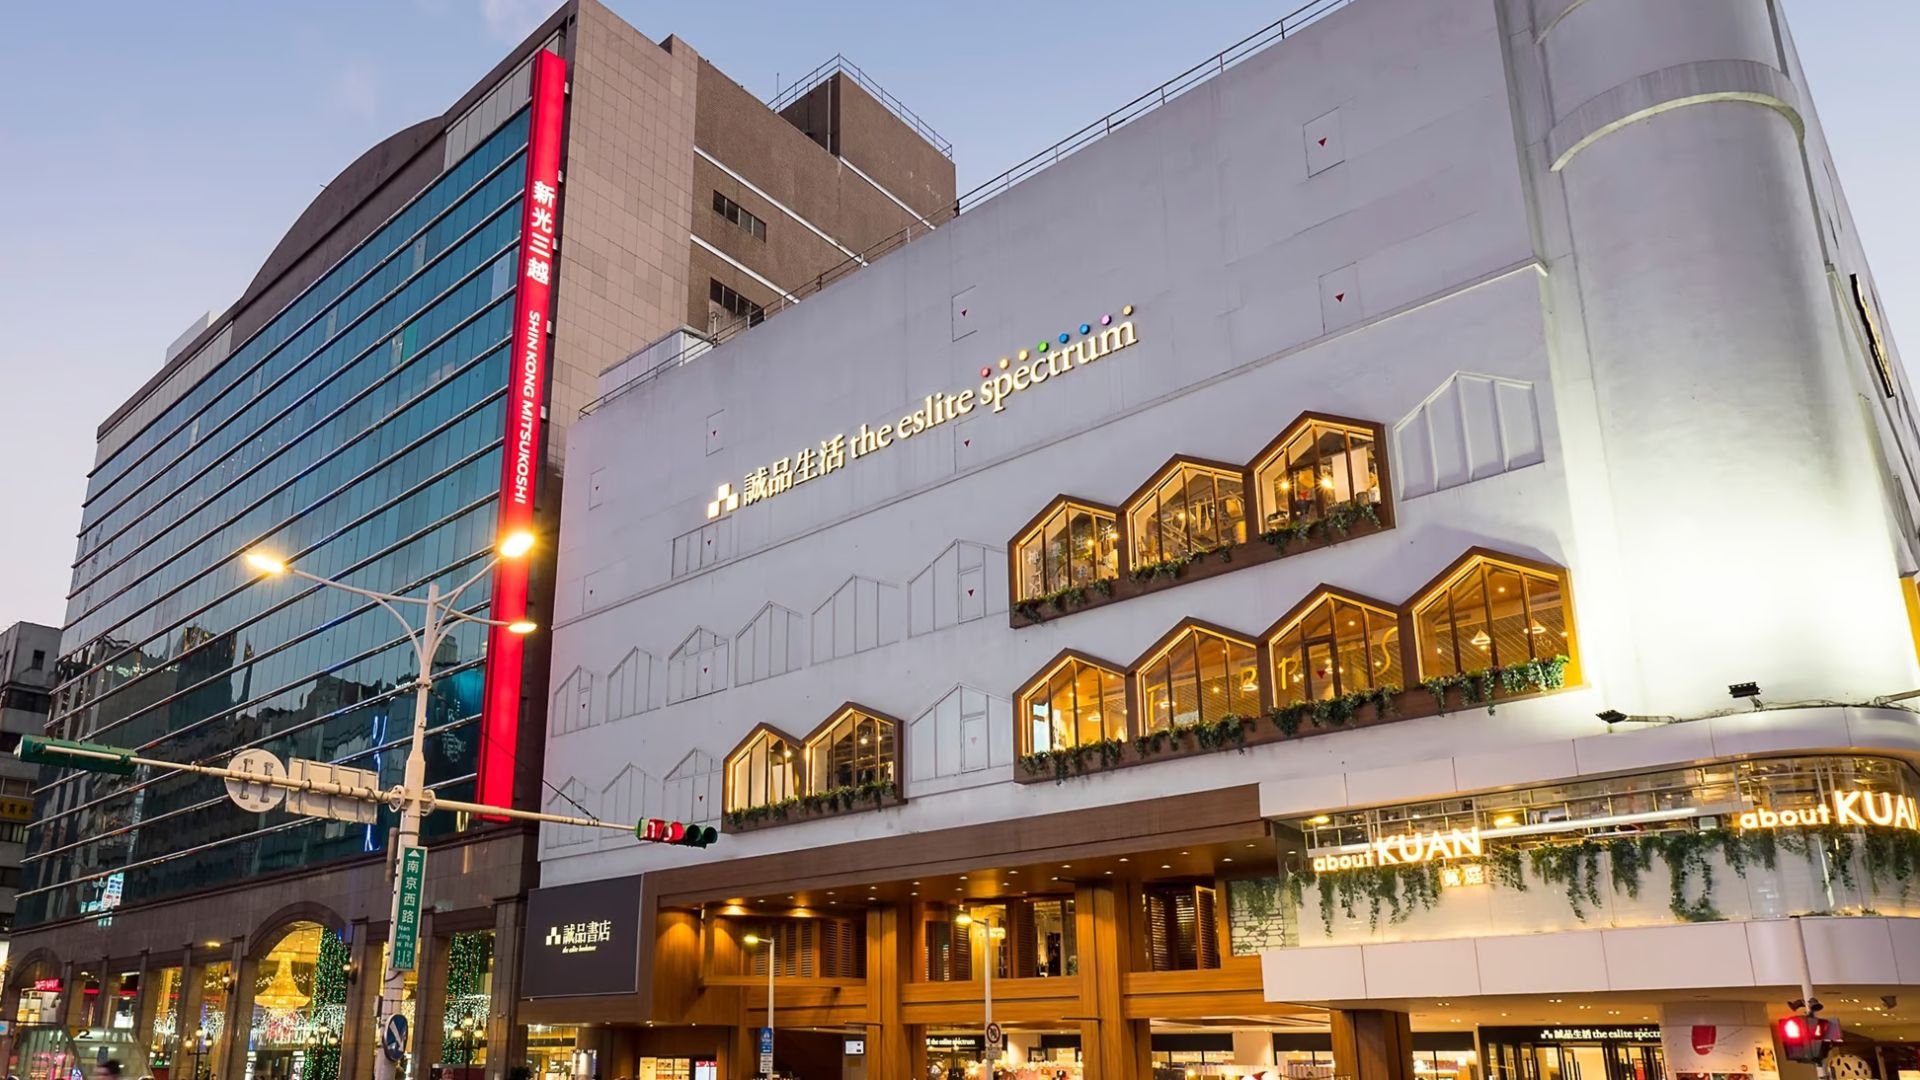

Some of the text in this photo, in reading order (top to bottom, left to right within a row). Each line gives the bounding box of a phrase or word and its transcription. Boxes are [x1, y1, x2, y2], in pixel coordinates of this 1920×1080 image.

[526, 180, 556, 286] 新光三越
[514, 310, 541, 505] SHIN KONG MITSUKOSHI
[743, 319, 1139, 506] 誠品生活 the eslite spectrum
[1739, 803, 1831, 830] about
[1313, 826, 1483, 872] about KUAN
[401, 860, 420, 924] 南京西路
[563, 920, 612, 945] 誠品書店
[1592, 1028, 1608, 1039] the
